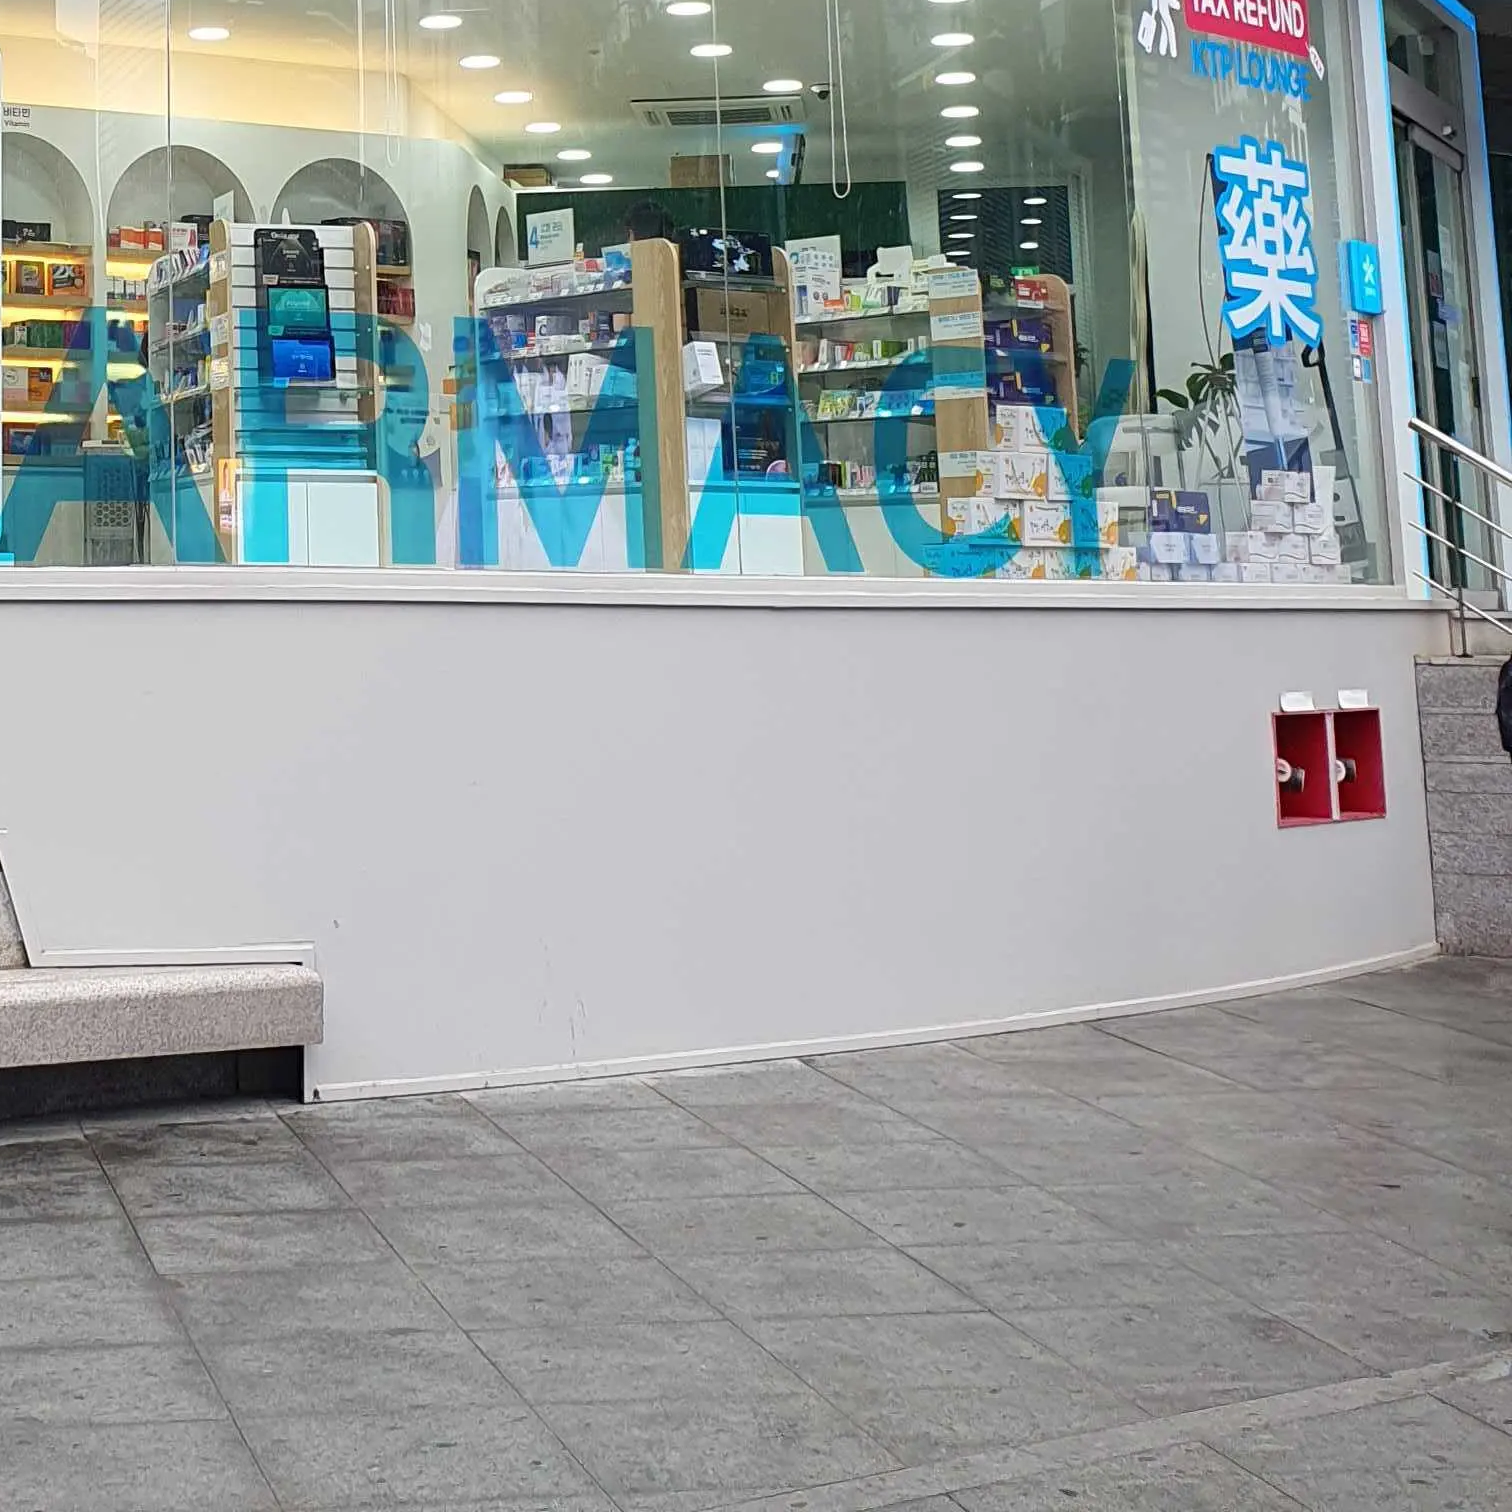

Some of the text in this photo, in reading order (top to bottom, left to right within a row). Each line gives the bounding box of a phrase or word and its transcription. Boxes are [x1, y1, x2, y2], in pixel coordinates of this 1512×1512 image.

[1191, 39, 1312, 102] KTP LOUNGE
[1217, 139, 1322, 344] 藥
